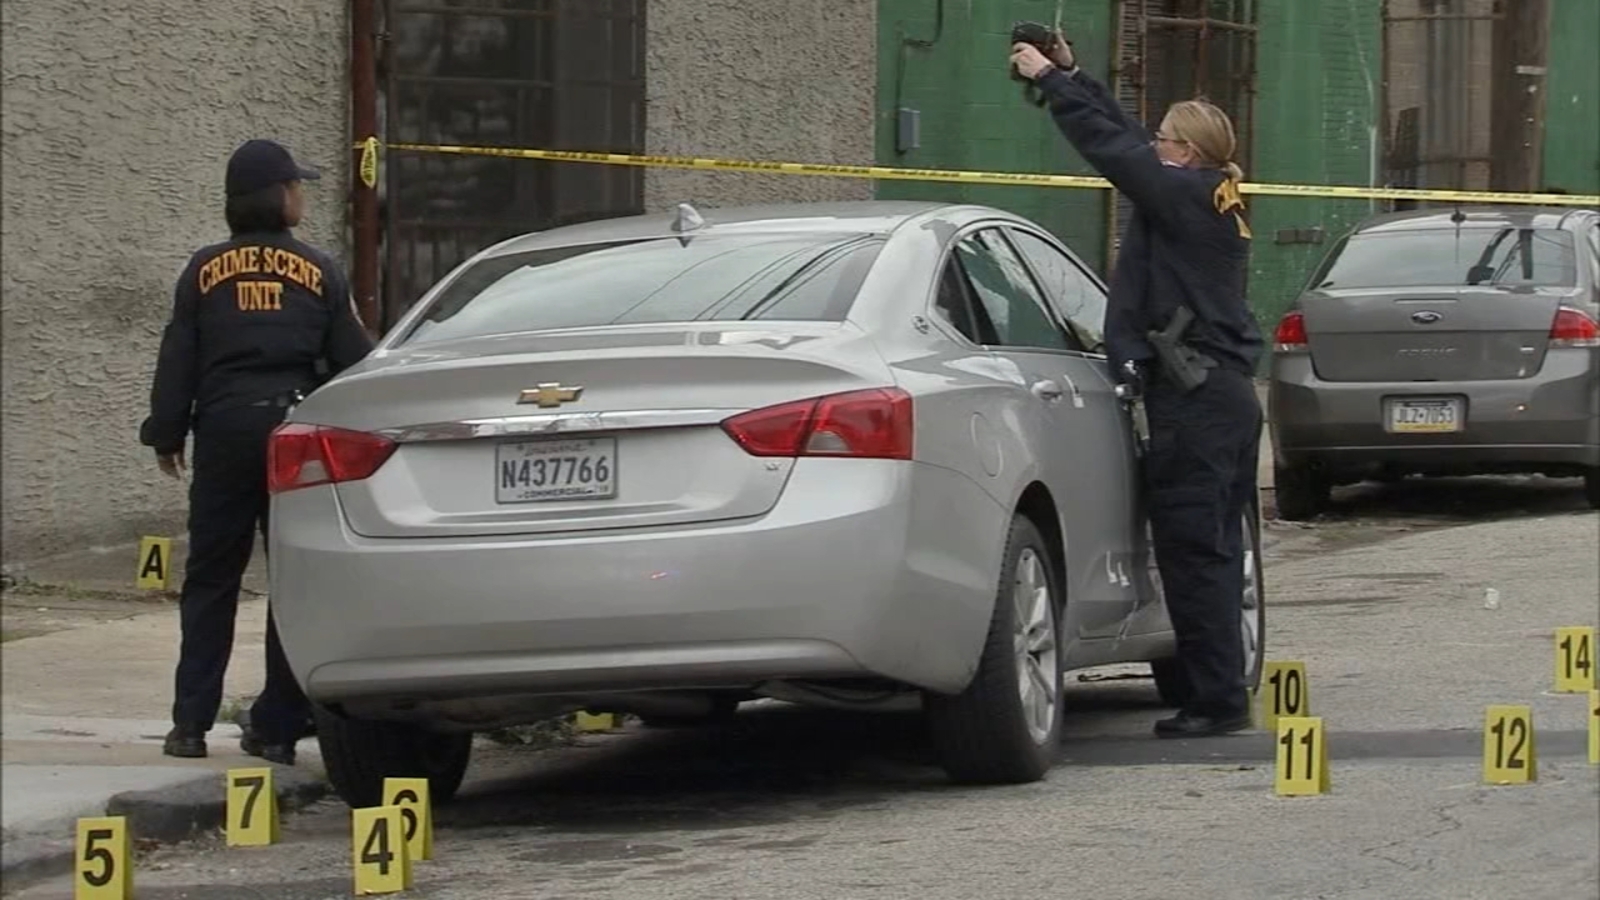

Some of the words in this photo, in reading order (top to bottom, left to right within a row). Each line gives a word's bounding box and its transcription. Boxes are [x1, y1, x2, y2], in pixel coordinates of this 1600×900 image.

[199, 245, 260, 294] CRIME
[263, 246, 323, 297] SCENE
[236, 280, 283, 311] UNIT
[501, 456, 609, 488] N437766
[141, 544, 164, 580] A
[1560, 634, 1591, 679] 14
[1269, 669, 1301, 715] 10
[1279, 727, 1315, 780] 11
[1491, 716, 1527, 769] 12
[233, 775, 265, 829] 7
[82, 829, 115, 887] 5
[361, 816, 394, 875] 4
